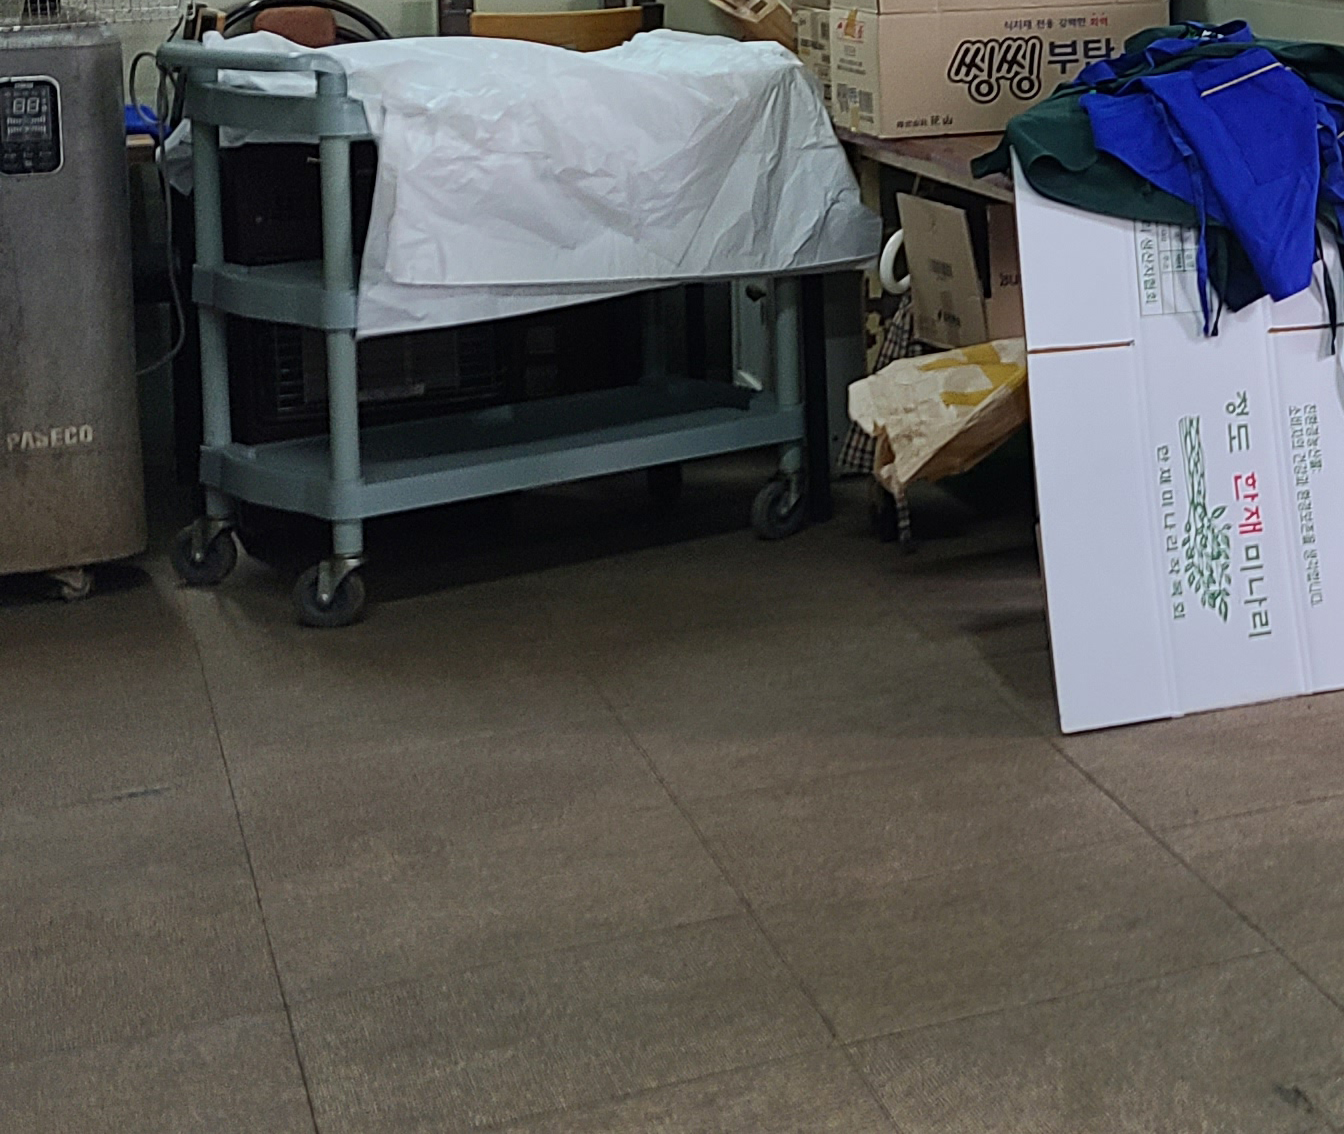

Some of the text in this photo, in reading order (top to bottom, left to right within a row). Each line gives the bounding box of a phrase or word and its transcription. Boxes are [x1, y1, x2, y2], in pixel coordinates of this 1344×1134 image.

[948, 36, 1117, 104] 씽씽 부탄
[7, 424, 94, 451] PASECO
